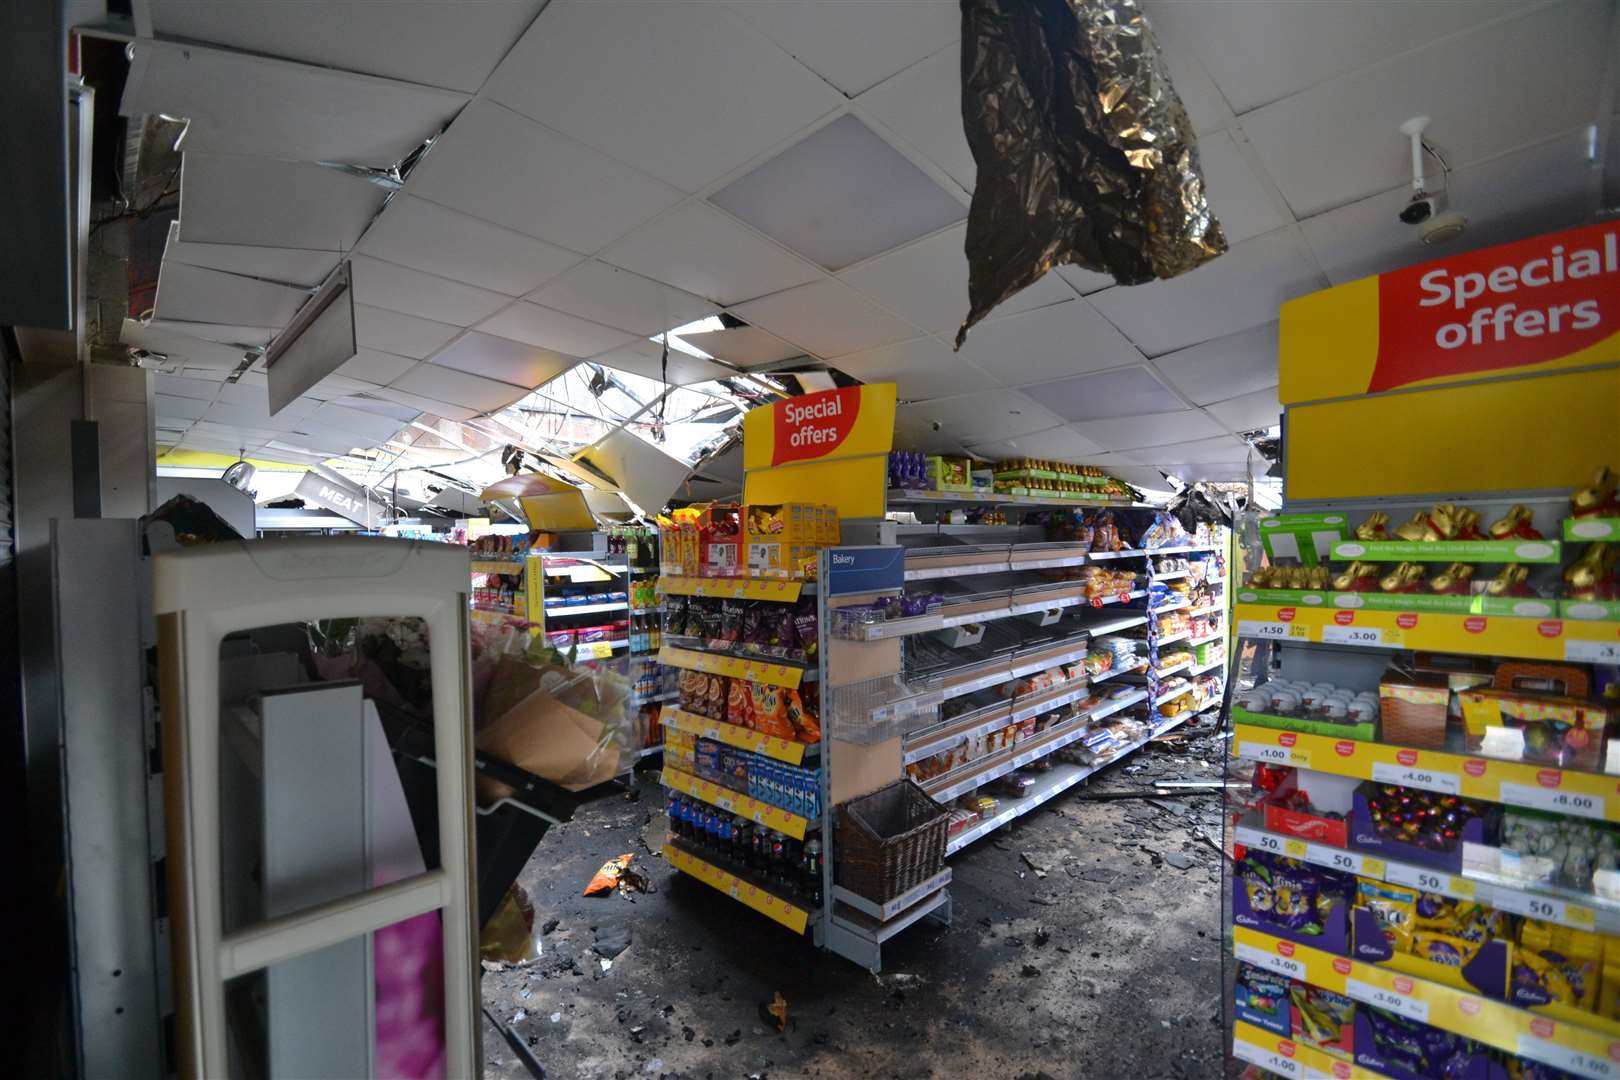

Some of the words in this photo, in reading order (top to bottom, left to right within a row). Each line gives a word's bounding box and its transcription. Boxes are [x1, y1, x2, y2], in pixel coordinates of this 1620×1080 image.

[1419, 232, 1618, 309] Special
[1435, 299, 1601, 349] offers
[784, 394, 842, 426] Special
[790, 425, 837, 447] offers
[319, 486, 363, 513] MEAT
[832, 554, 855, 566] Bakery
